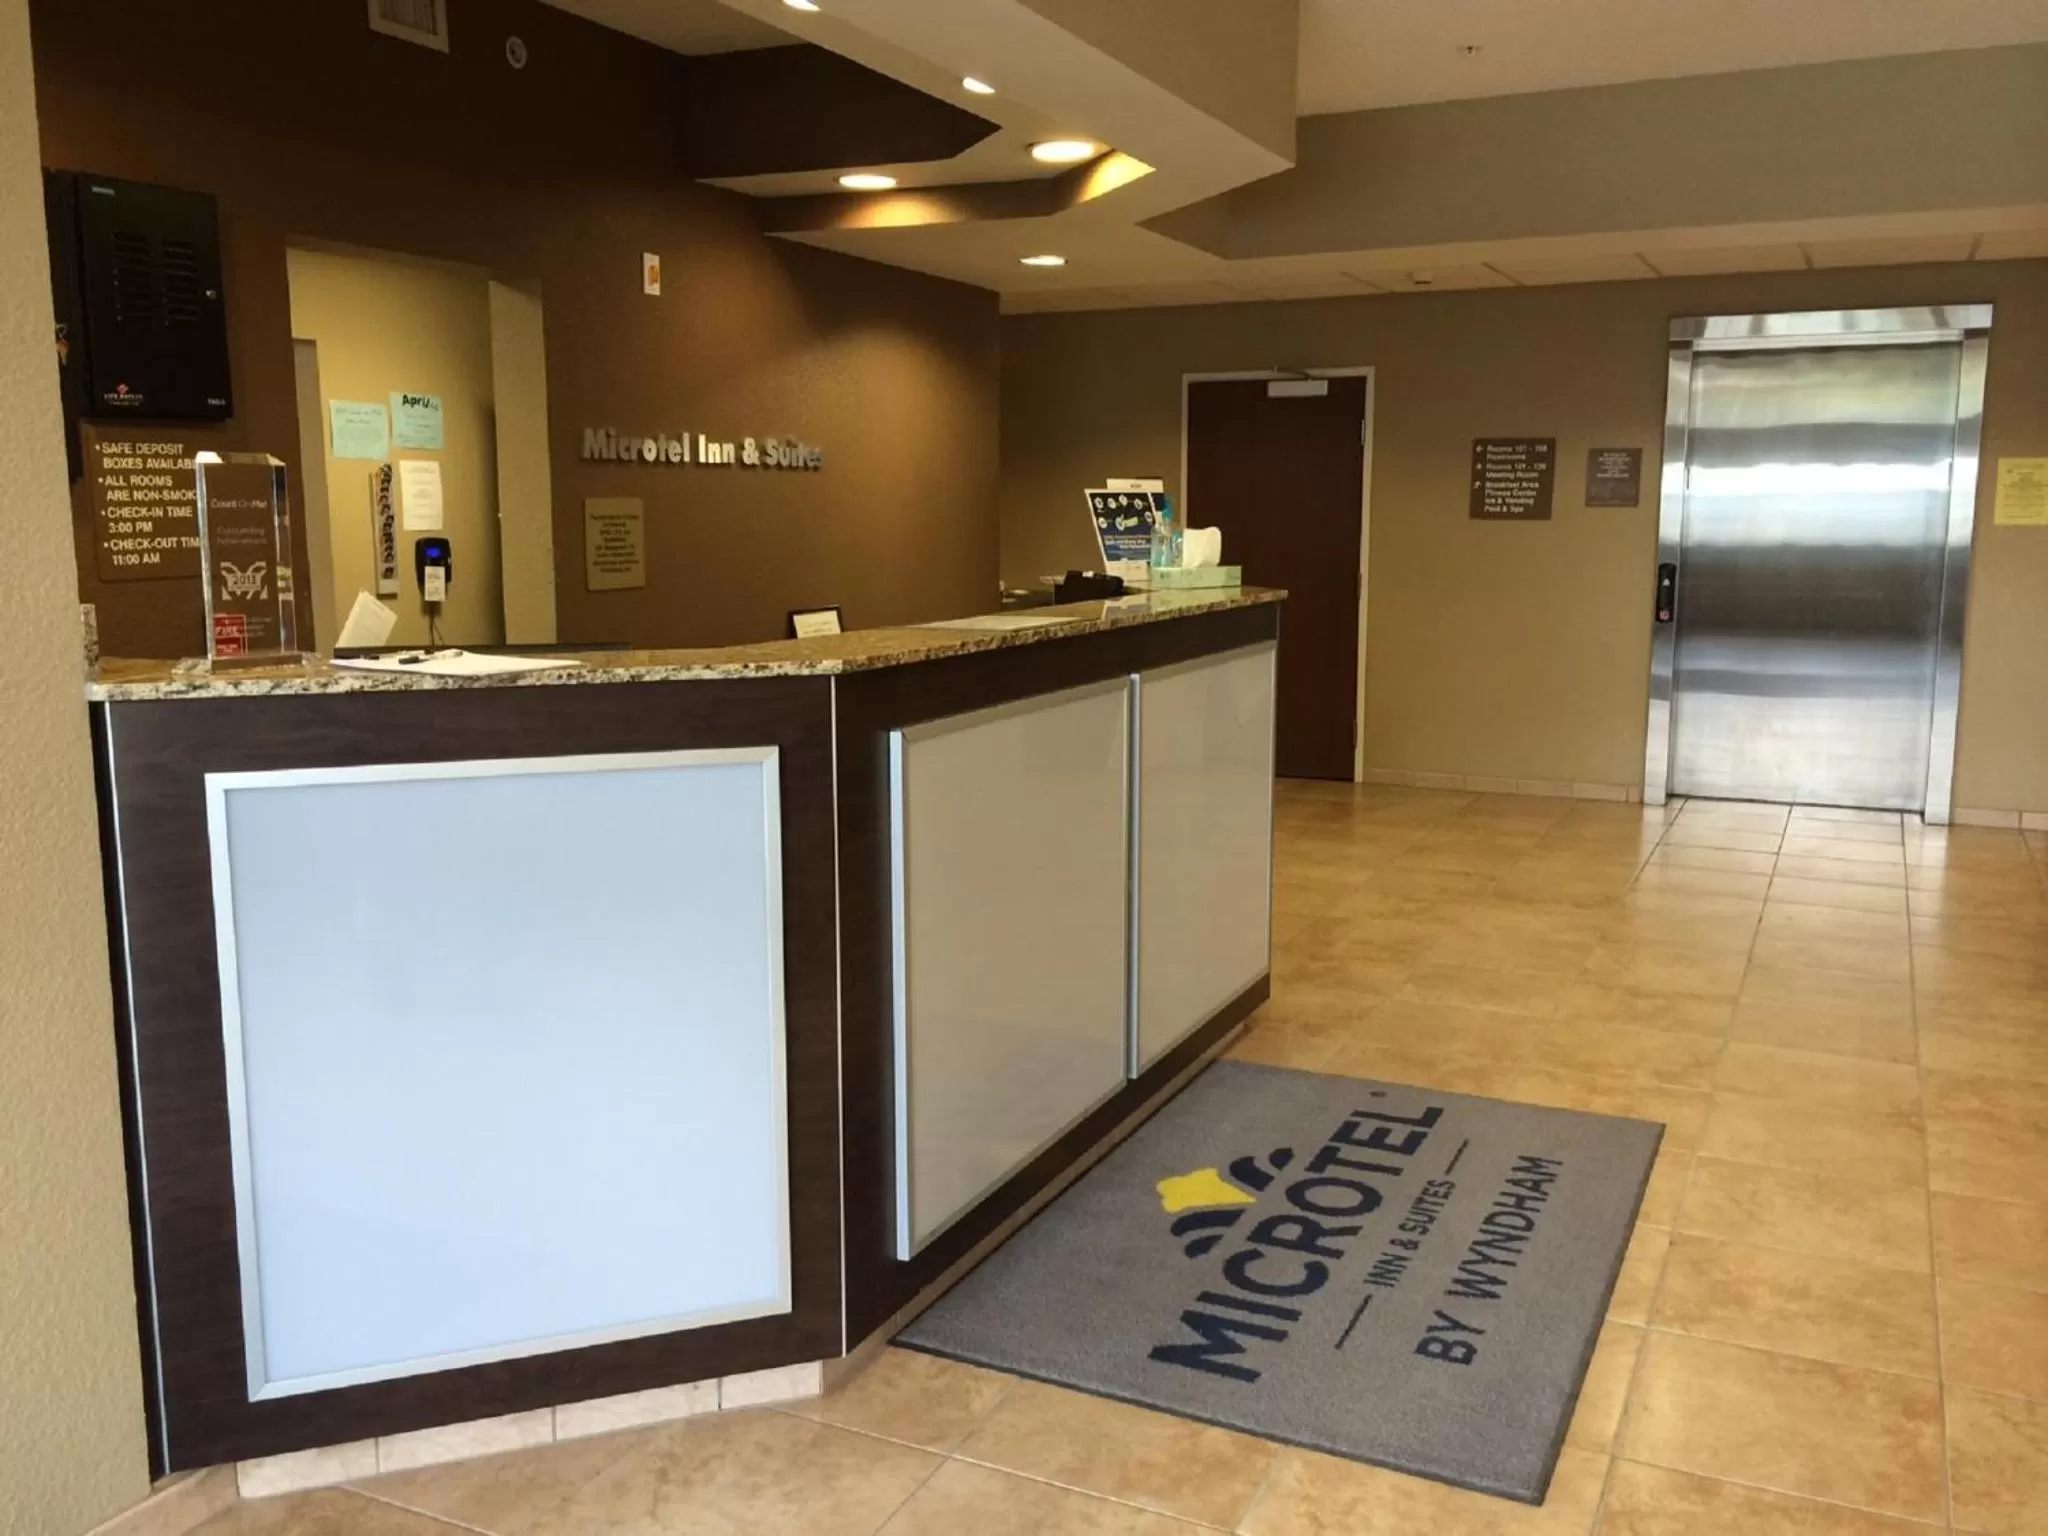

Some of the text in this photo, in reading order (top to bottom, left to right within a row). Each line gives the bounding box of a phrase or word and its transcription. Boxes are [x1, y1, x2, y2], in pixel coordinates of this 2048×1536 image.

[102, 442, 184, 455] SAFE DEPOSIT
[583, 427, 824, 470] Microtel Inn & Suites
[103, 457, 143, 469] BOXES
[105, 475, 173, 486] ALL ROOMS
[1486, 471, 1515, 480] Meeting
[106, 489, 131, 501] ARE
[1504, 498, 1534, 506] Vending
[107, 506, 193, 519] CHECK-IN TIME
[108, 521, 153, 533] 3:00 PM
[110, 537, 178, 551] CHECK-OUT
[112, 552, 161, 566] 11:00 AM
[1365, 1178, 1456, 1288] INN & SUITES
[1147, 1104, 1445, 1385] MICROTEL
[1415, 1154, 1565, 1367] BY WYNDHAM
